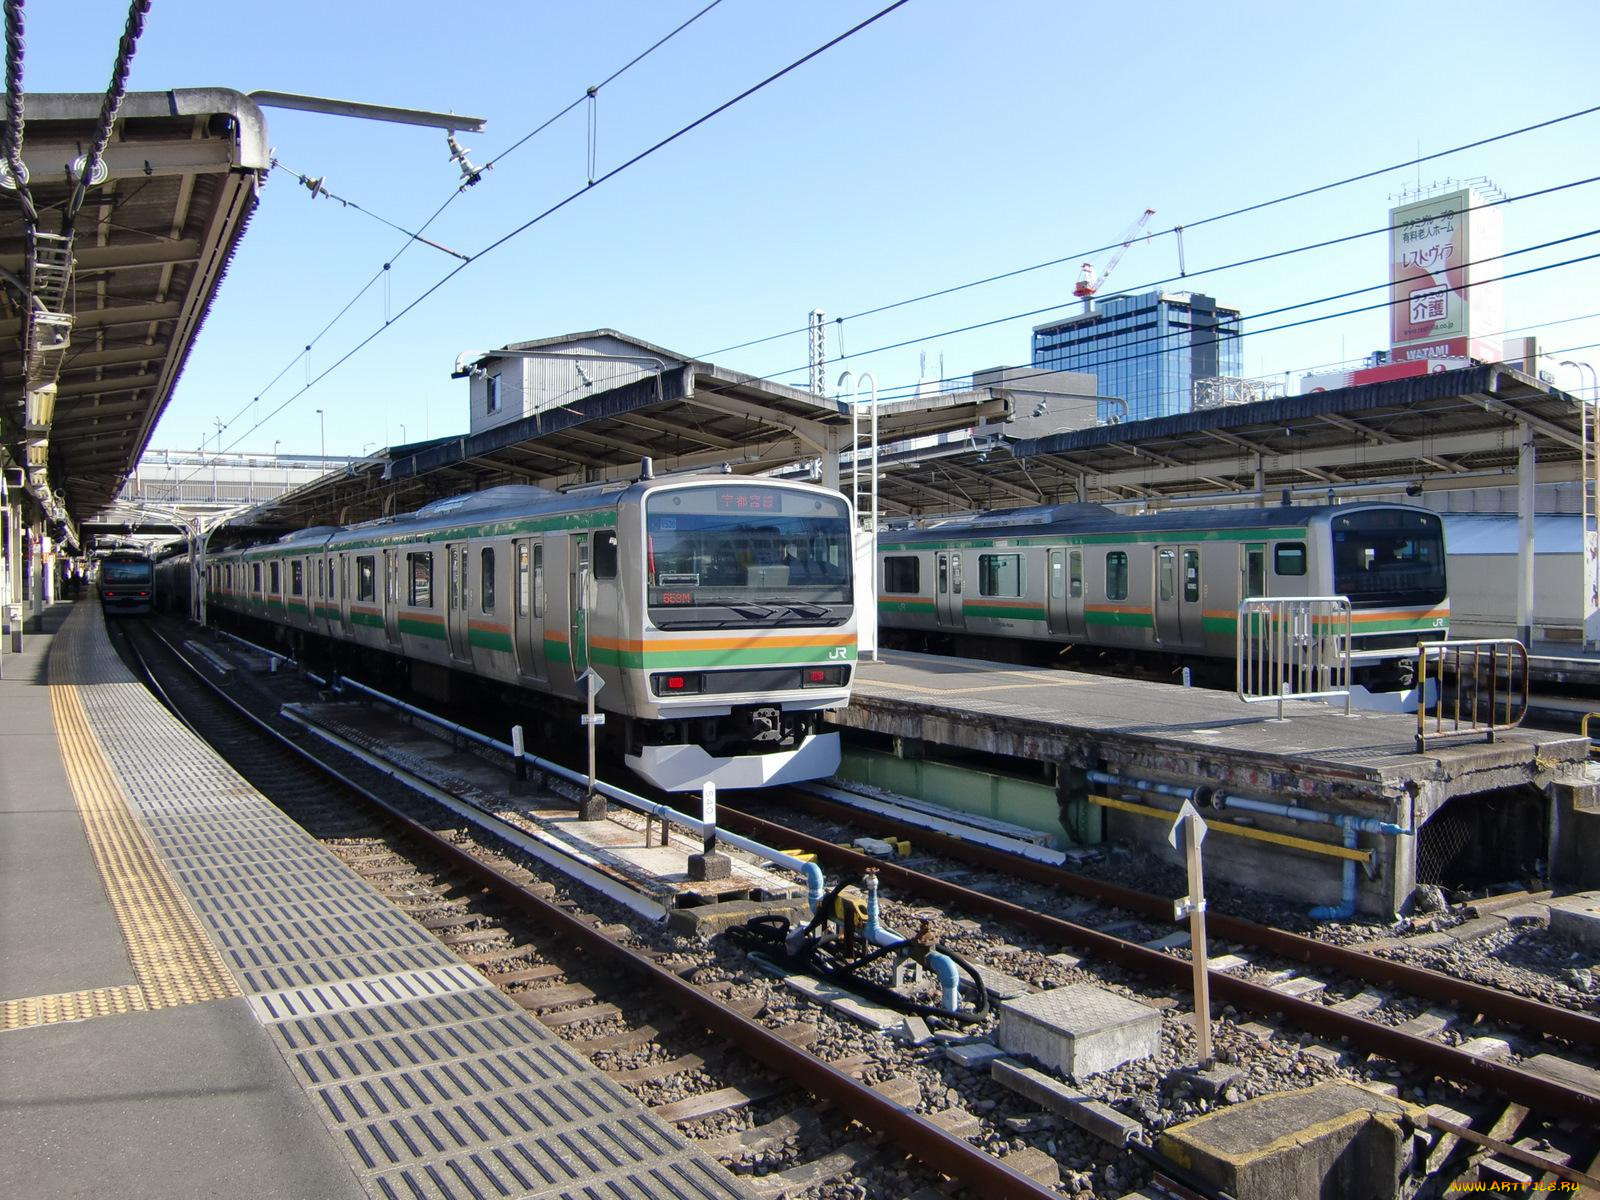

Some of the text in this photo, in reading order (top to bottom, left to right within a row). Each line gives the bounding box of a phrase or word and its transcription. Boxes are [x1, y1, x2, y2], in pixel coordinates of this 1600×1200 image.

[1402, 221, 1454, 243] 有料老人ホーム
[1412, 299, 1445, 320] 介護
[1406, 344, 1449, 360] WATAMI
[1432, 617, 1443, 627] JR
[828, 646, 847, 659] JR
